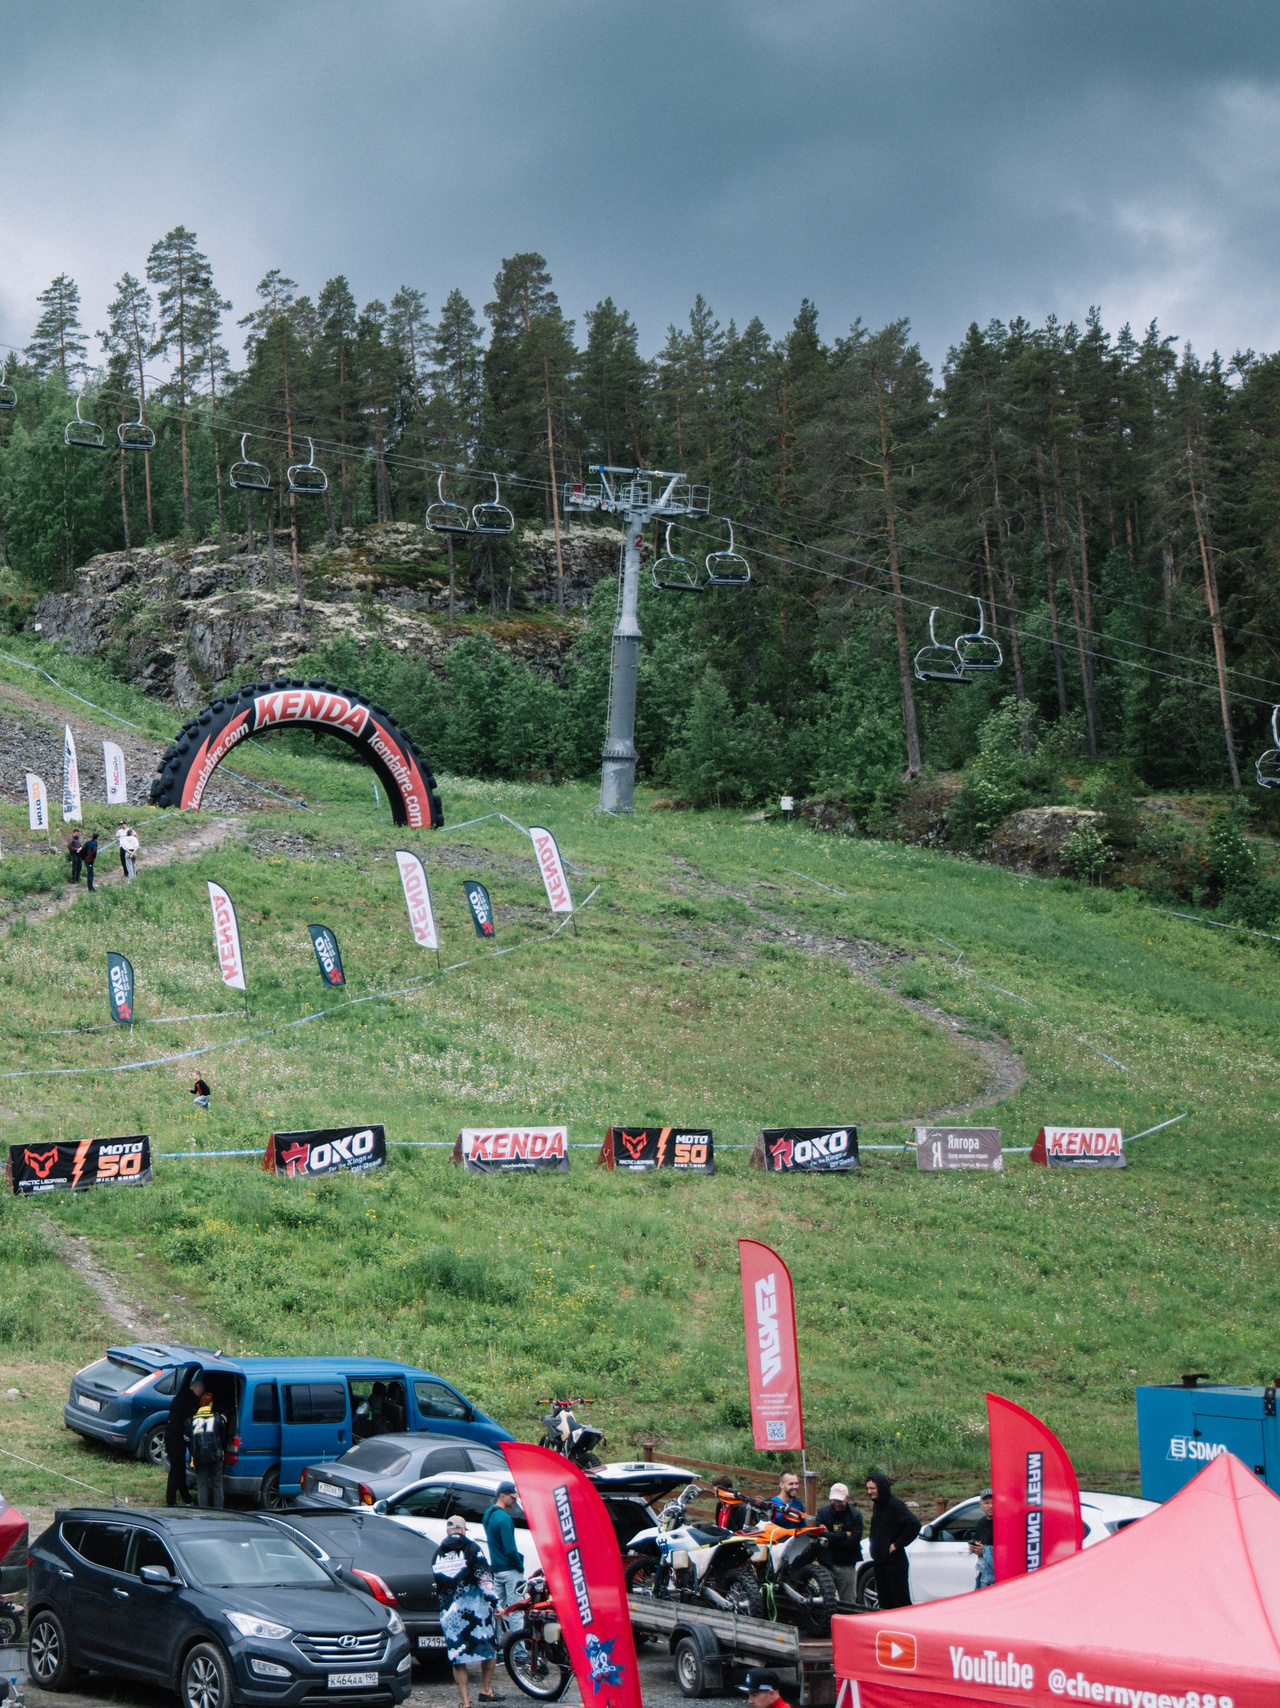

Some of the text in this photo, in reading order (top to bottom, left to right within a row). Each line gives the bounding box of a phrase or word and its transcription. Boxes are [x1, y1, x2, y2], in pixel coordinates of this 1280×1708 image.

[634, 533, 643, 548] 2
[257, 692, 369, 735] KENDA
[188, 722, 249, 809] kendatire.com
[367, 730, 422, 829] kendatire.com
[99, 1142, 143, 1156] MOTO
[469, 1132, 565, 1161] KENDA
[675, 1135, 709, 1144] MOTO
[947, 1134, 979, 1153] Ялгора
[1050, 1132, 1120, 1155] KENDA
[346, 1156, 367, 1166] Kings
[674, 1144, 708, 1164] 50
[96, 1152, 142, 1178] 50
[40, 1177, 68, 1185] LEOPARD
[192, 1417, 215, 1434] 21
[949, 1645, 1034, 1689] YouTube
[330, 1673, 376, 1686] К464АА 190
